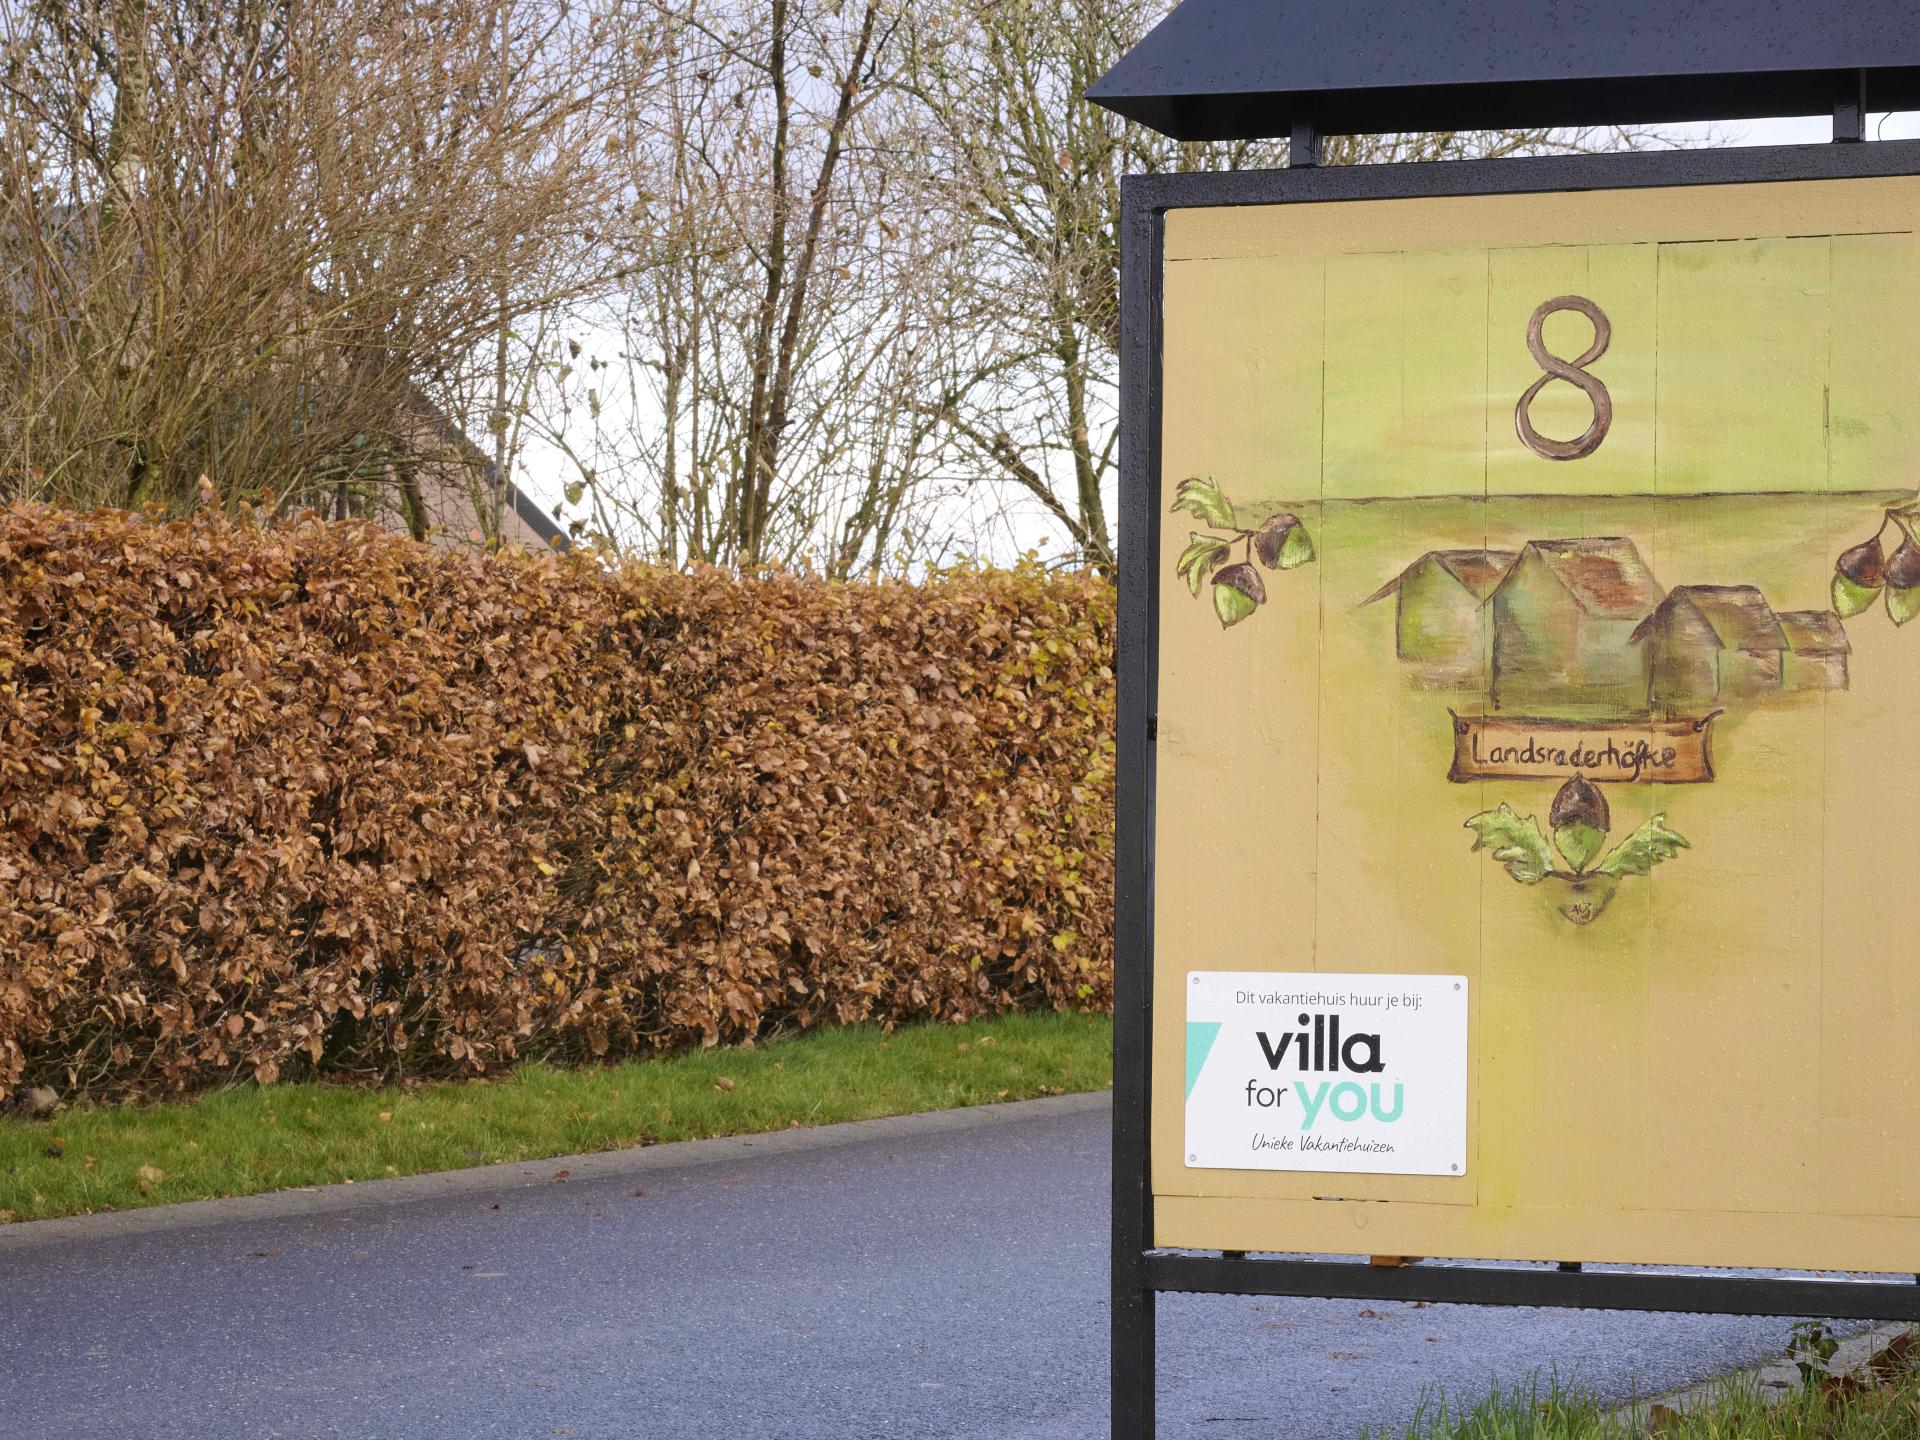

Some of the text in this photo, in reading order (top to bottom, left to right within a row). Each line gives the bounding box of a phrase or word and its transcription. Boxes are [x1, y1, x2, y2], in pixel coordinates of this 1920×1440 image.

[1515, 294, 1612, 461] 8
[1235, 991, 1422, 1010] Dit vakantiehuis huur je bij:
[1255, 1012, 1386, 1074] villa
[1245, 1079, 1404, 1130] for you
[1252, 1133, 1395, 1153] Unieke Vakantiehuizen
